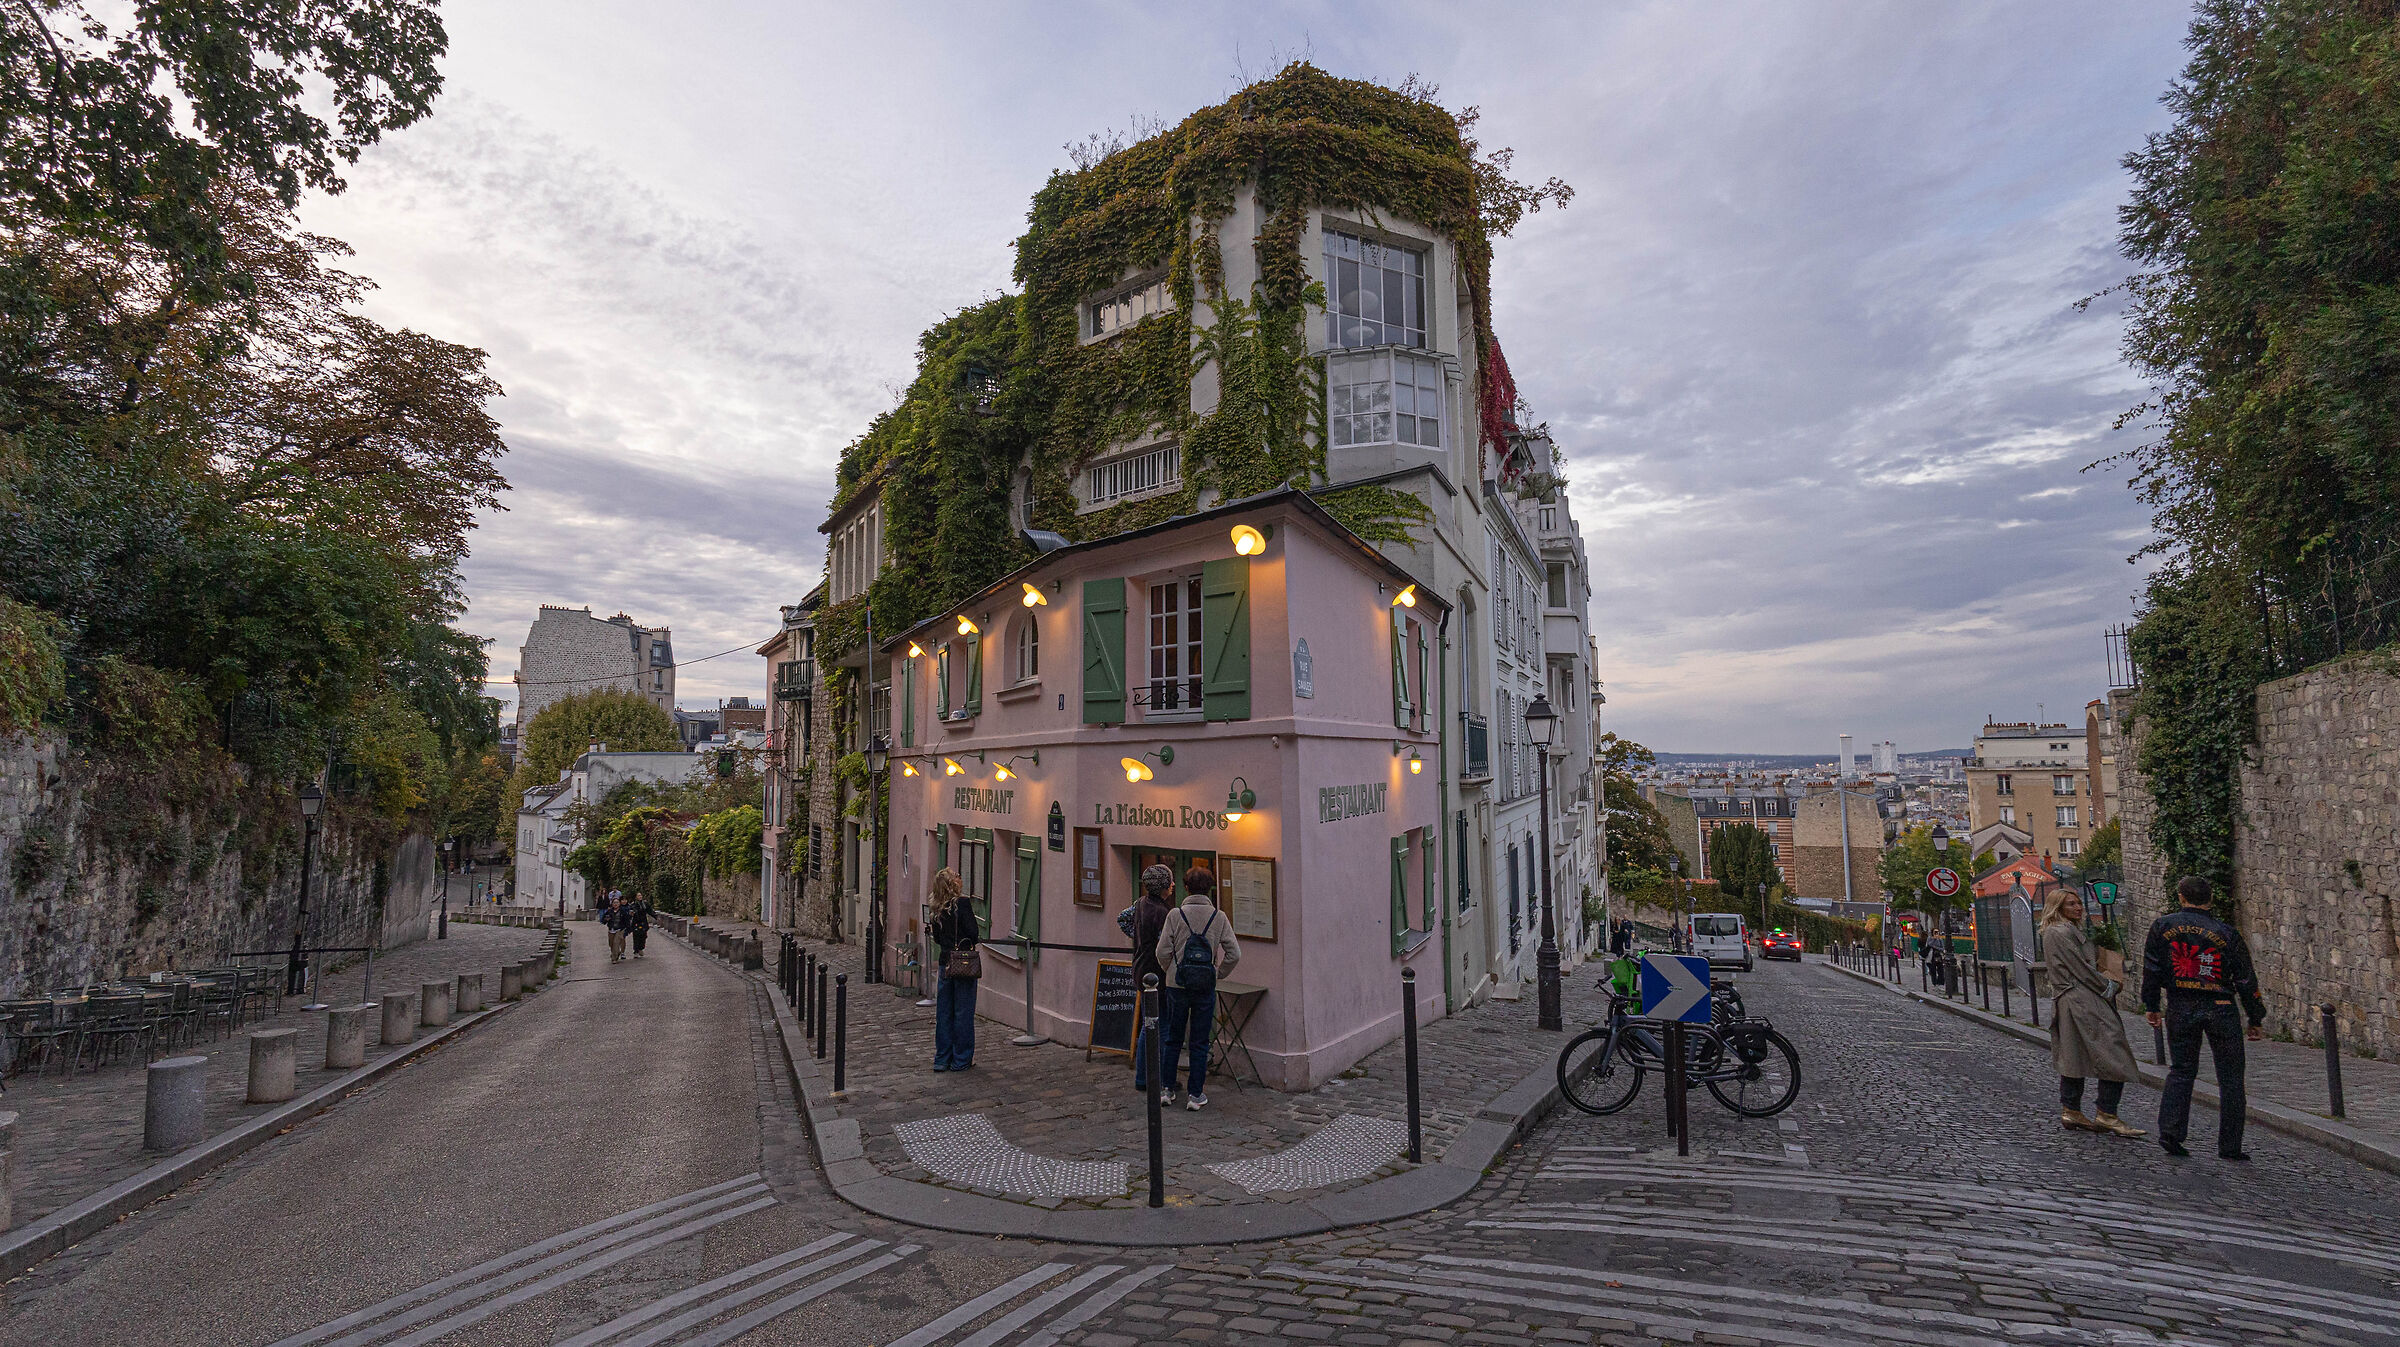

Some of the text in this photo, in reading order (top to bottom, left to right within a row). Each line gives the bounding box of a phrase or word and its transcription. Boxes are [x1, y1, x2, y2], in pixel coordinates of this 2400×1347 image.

[954, 787, 1014, 814] RESTAURANT
[1319, 782, 1387, 824] RESTAURANT
[1095, 803, 1114, 825] La
[1116, 803, 1176, 828] Maison
[2023, 872, 2044, 880] AGILE
